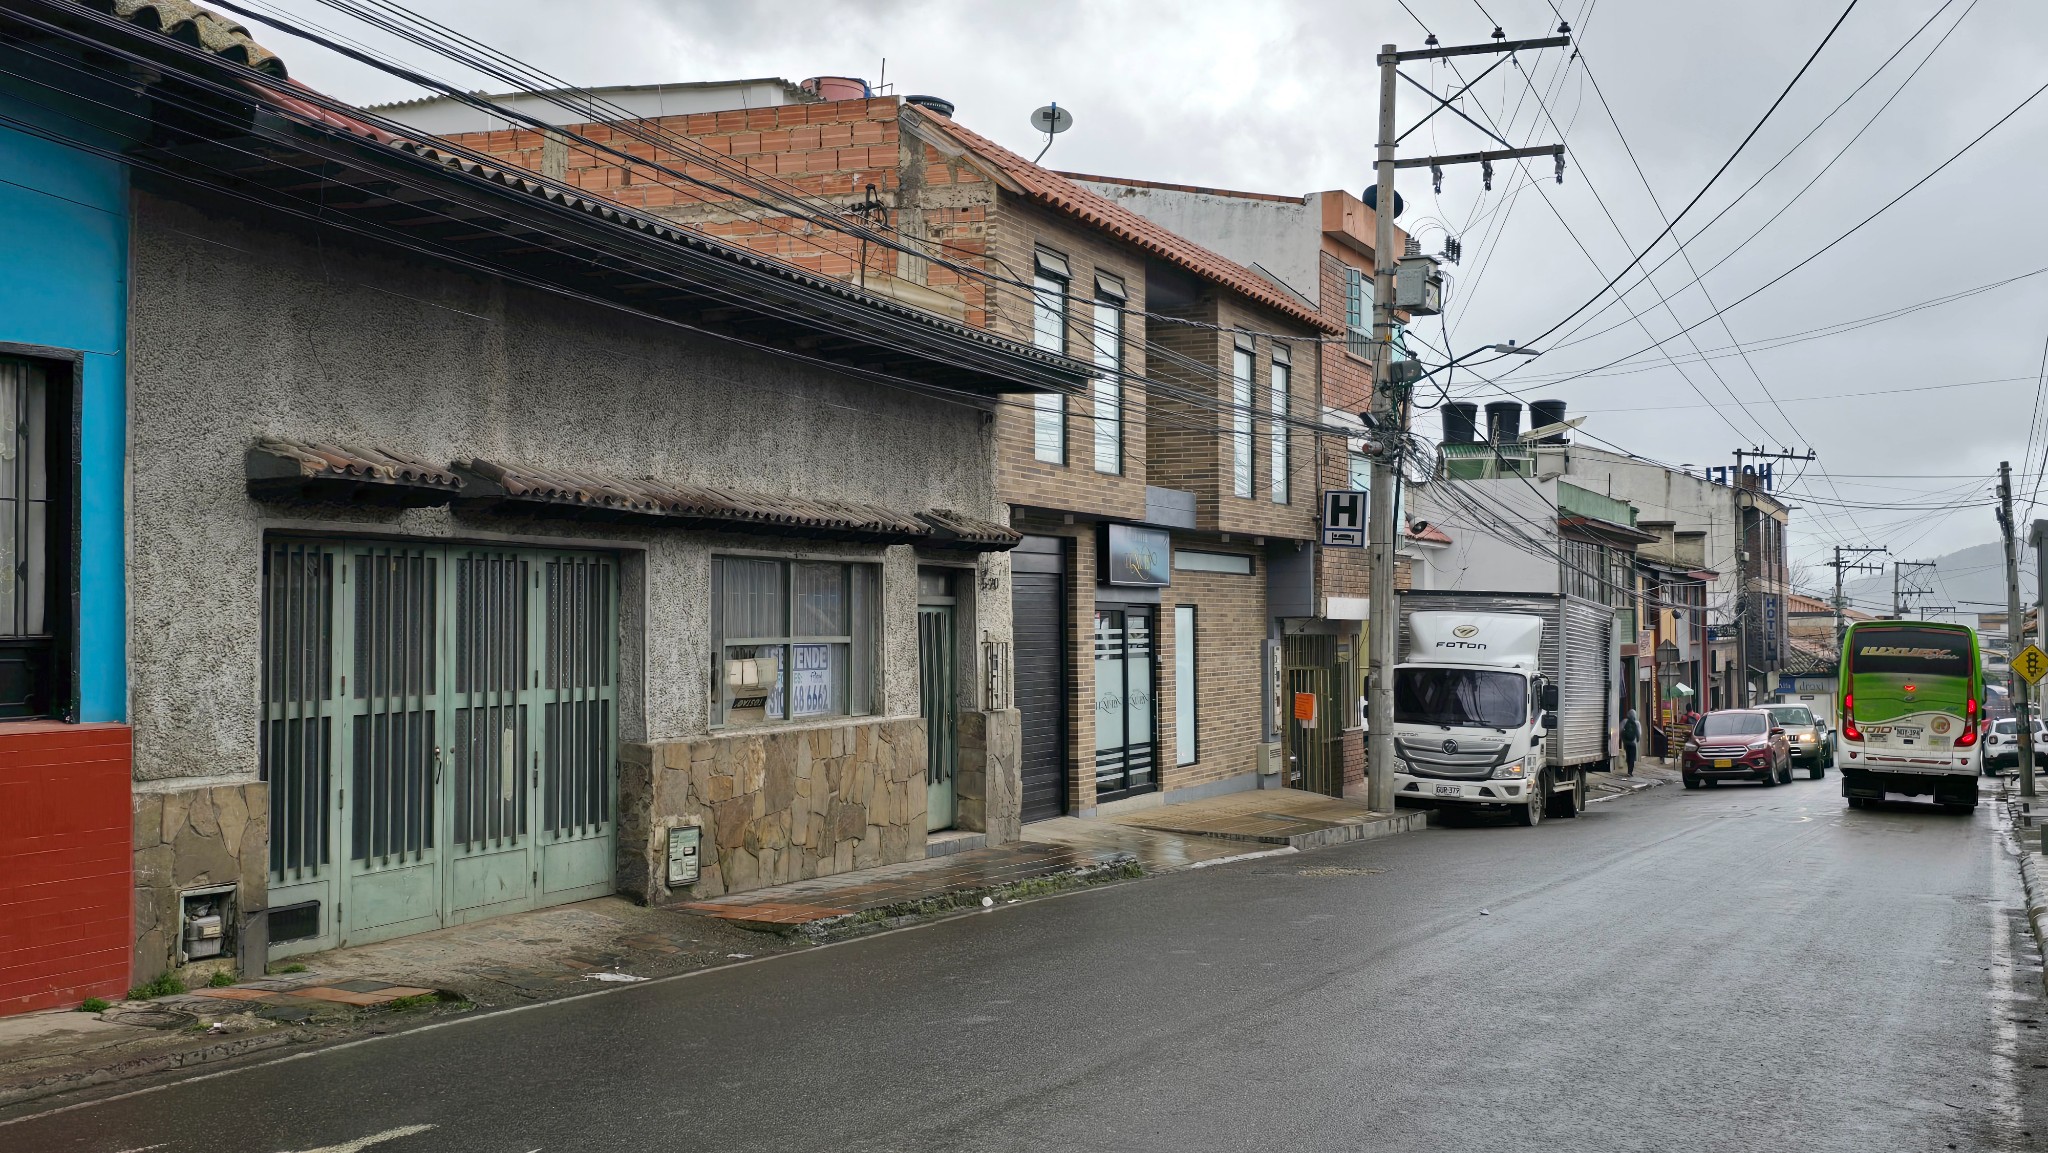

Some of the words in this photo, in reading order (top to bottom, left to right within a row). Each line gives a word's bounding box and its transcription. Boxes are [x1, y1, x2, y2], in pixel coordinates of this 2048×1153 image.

[1331, 495, 1358, 527] H
[1766, 598, 1776, 652] HOTEL
[1861, 725, 1892, 734] 1010
